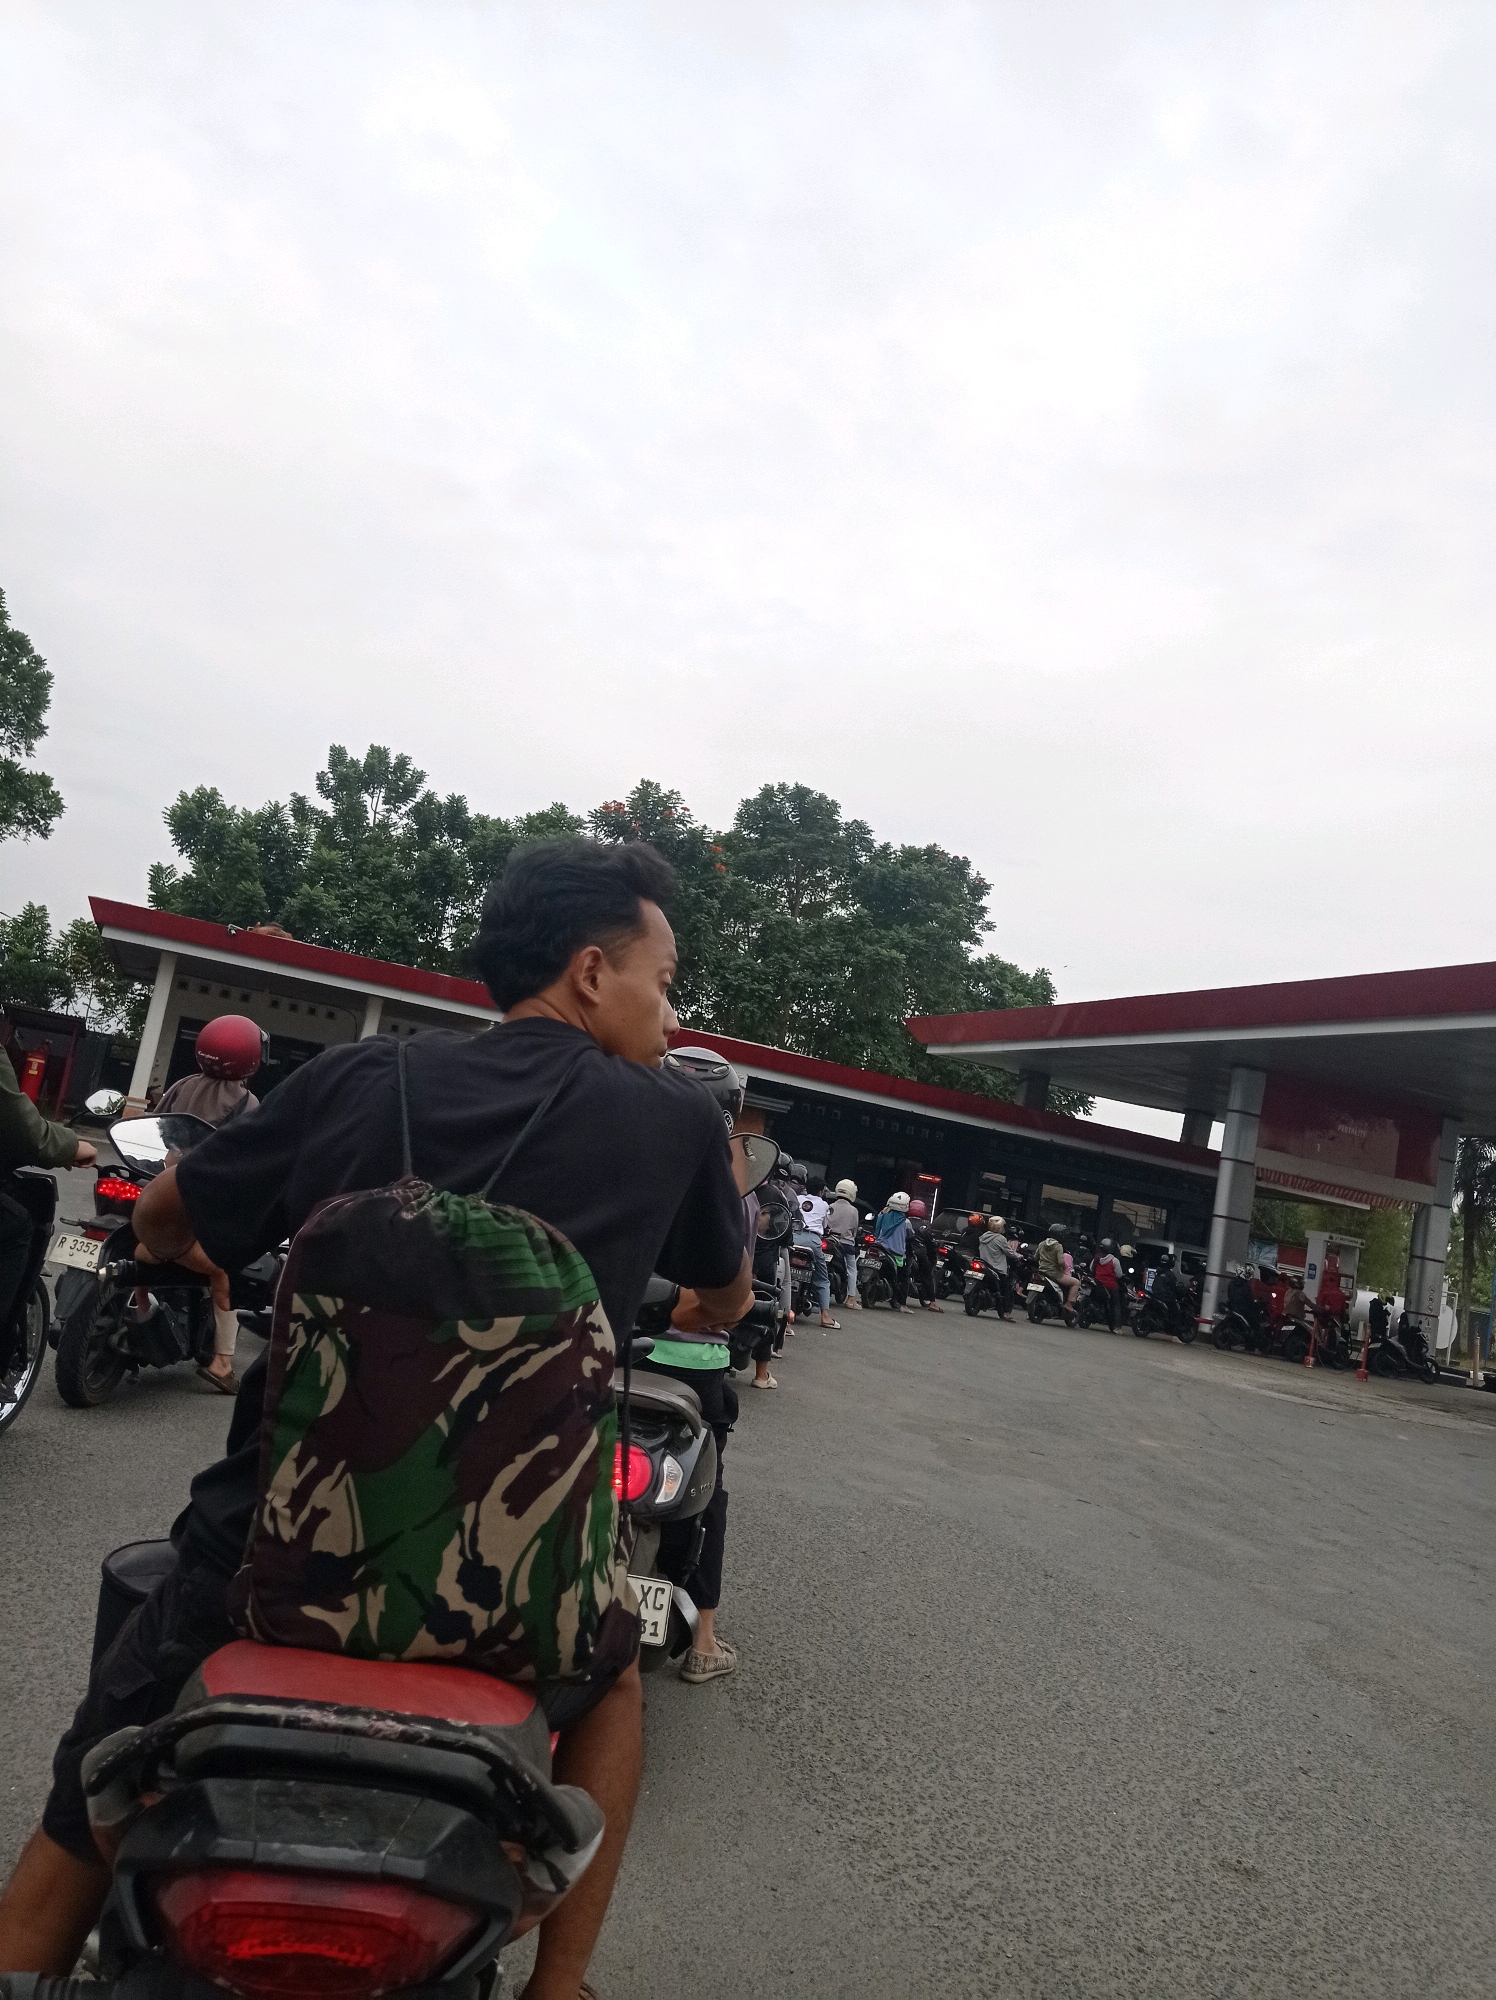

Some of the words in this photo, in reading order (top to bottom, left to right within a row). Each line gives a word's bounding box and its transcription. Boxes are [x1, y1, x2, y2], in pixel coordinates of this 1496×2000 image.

[58, 1236, 68, 1249] R
[69, 1239, 99, 1256] 3352
[639, 1584, 666, 1611] XC
